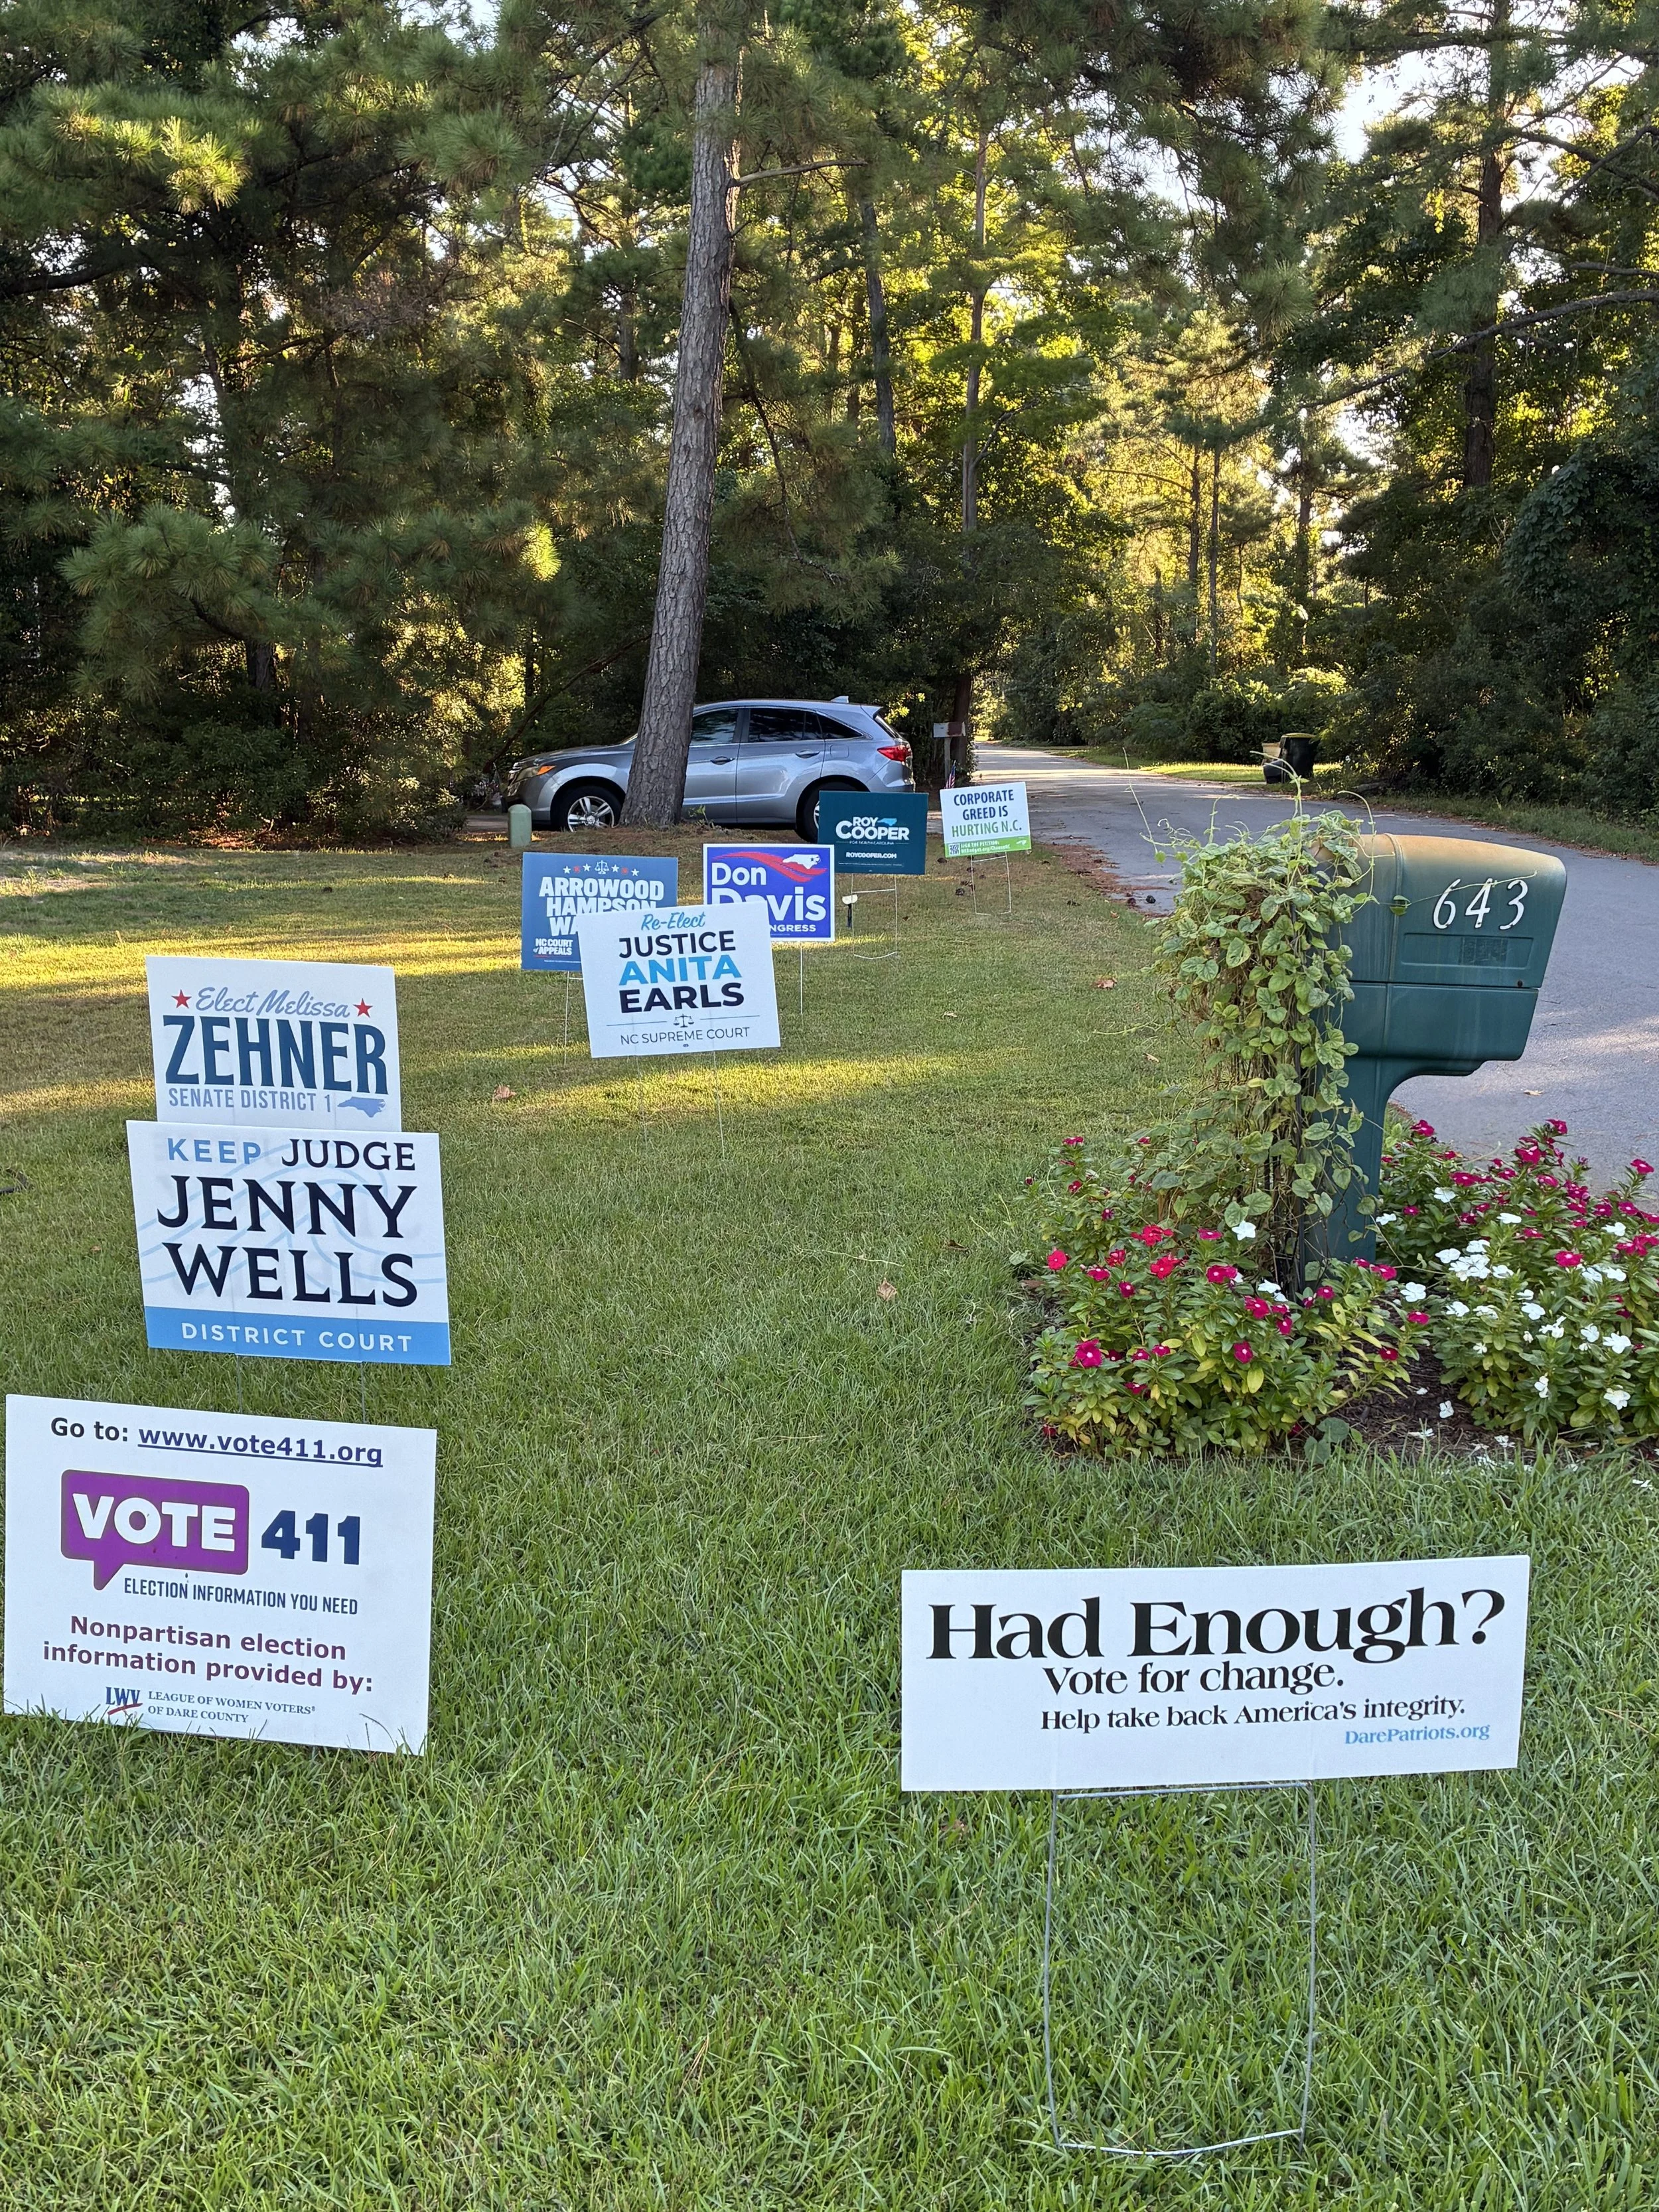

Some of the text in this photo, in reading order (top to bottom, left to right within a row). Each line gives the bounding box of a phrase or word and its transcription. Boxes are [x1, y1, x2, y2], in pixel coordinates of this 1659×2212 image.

[954, 789, 1014, 806] CORPORATE
[853, 816, 879, 827] ROY
[962, 805, 1008, 820] GREED IS
[835, 820, 910, 840] COOPER
[952, 820, 1022, 837] HURTING N.C.
[711, 862, 766, 885] Don
[539, 877, 664, 901] ARROWOOD
[1432, 877, 1528, 930] 643
[711, 887, 826, 921] Dvis
[641, 911, 706, 930] Re-Elect
[536, 938, 573, 947] NC COURT
[538, 946, 572, 955] APPEALS
[618, 930, 736, 959] JUSTICE
[618, 954, 742, 986] ANITA
[195, 987, 350, 1017] Elect Melissa
[619, 982, 745, 1013] EARLS
[620, 1027, 750, 1045] NC SUPREME COURT
[163, 1015, 388, 1095] ZEHNER
[169, 1088, 332, 1113] SENATE DISTRICT 1
[167, 1138, 415, 1171] KEEP JUDGE
[157, 1176, 417, 1238] JENNY
[162, 1243, 417, 1307] WELLS
[182, 1323, 411, 1352] DISTRICT COURT
[51, 1417, 383, 1467] Go to: www.vote411.org
[72, 1493, 360, 1566] VOTE 411
[124, 1578, 358, 1615] ELECTION INFORMATION YOU NEED
[71, 1616, 346, 1660] Nonpartisan election
[926, 1587, 1506, 1663] Had Enough?
[43, 1641, 373, 1694] information provided by:
[1043, 1660, 1344, 1696] Vote for change.
[106, 1687, 141, 1706] LWV
[148, 1691, 194, 1704] LEAGUE
[197, 1695, 214, 1706] OF
[215, 1697, 262, 1710] WOMEN
[148, 1705, 249, 1723] OF DARE COUNTY
[1041, 1696, 1466, 1733] Help take back America's integrity.
[1344, 1725, 1490, 1745] DarePatriots.org
